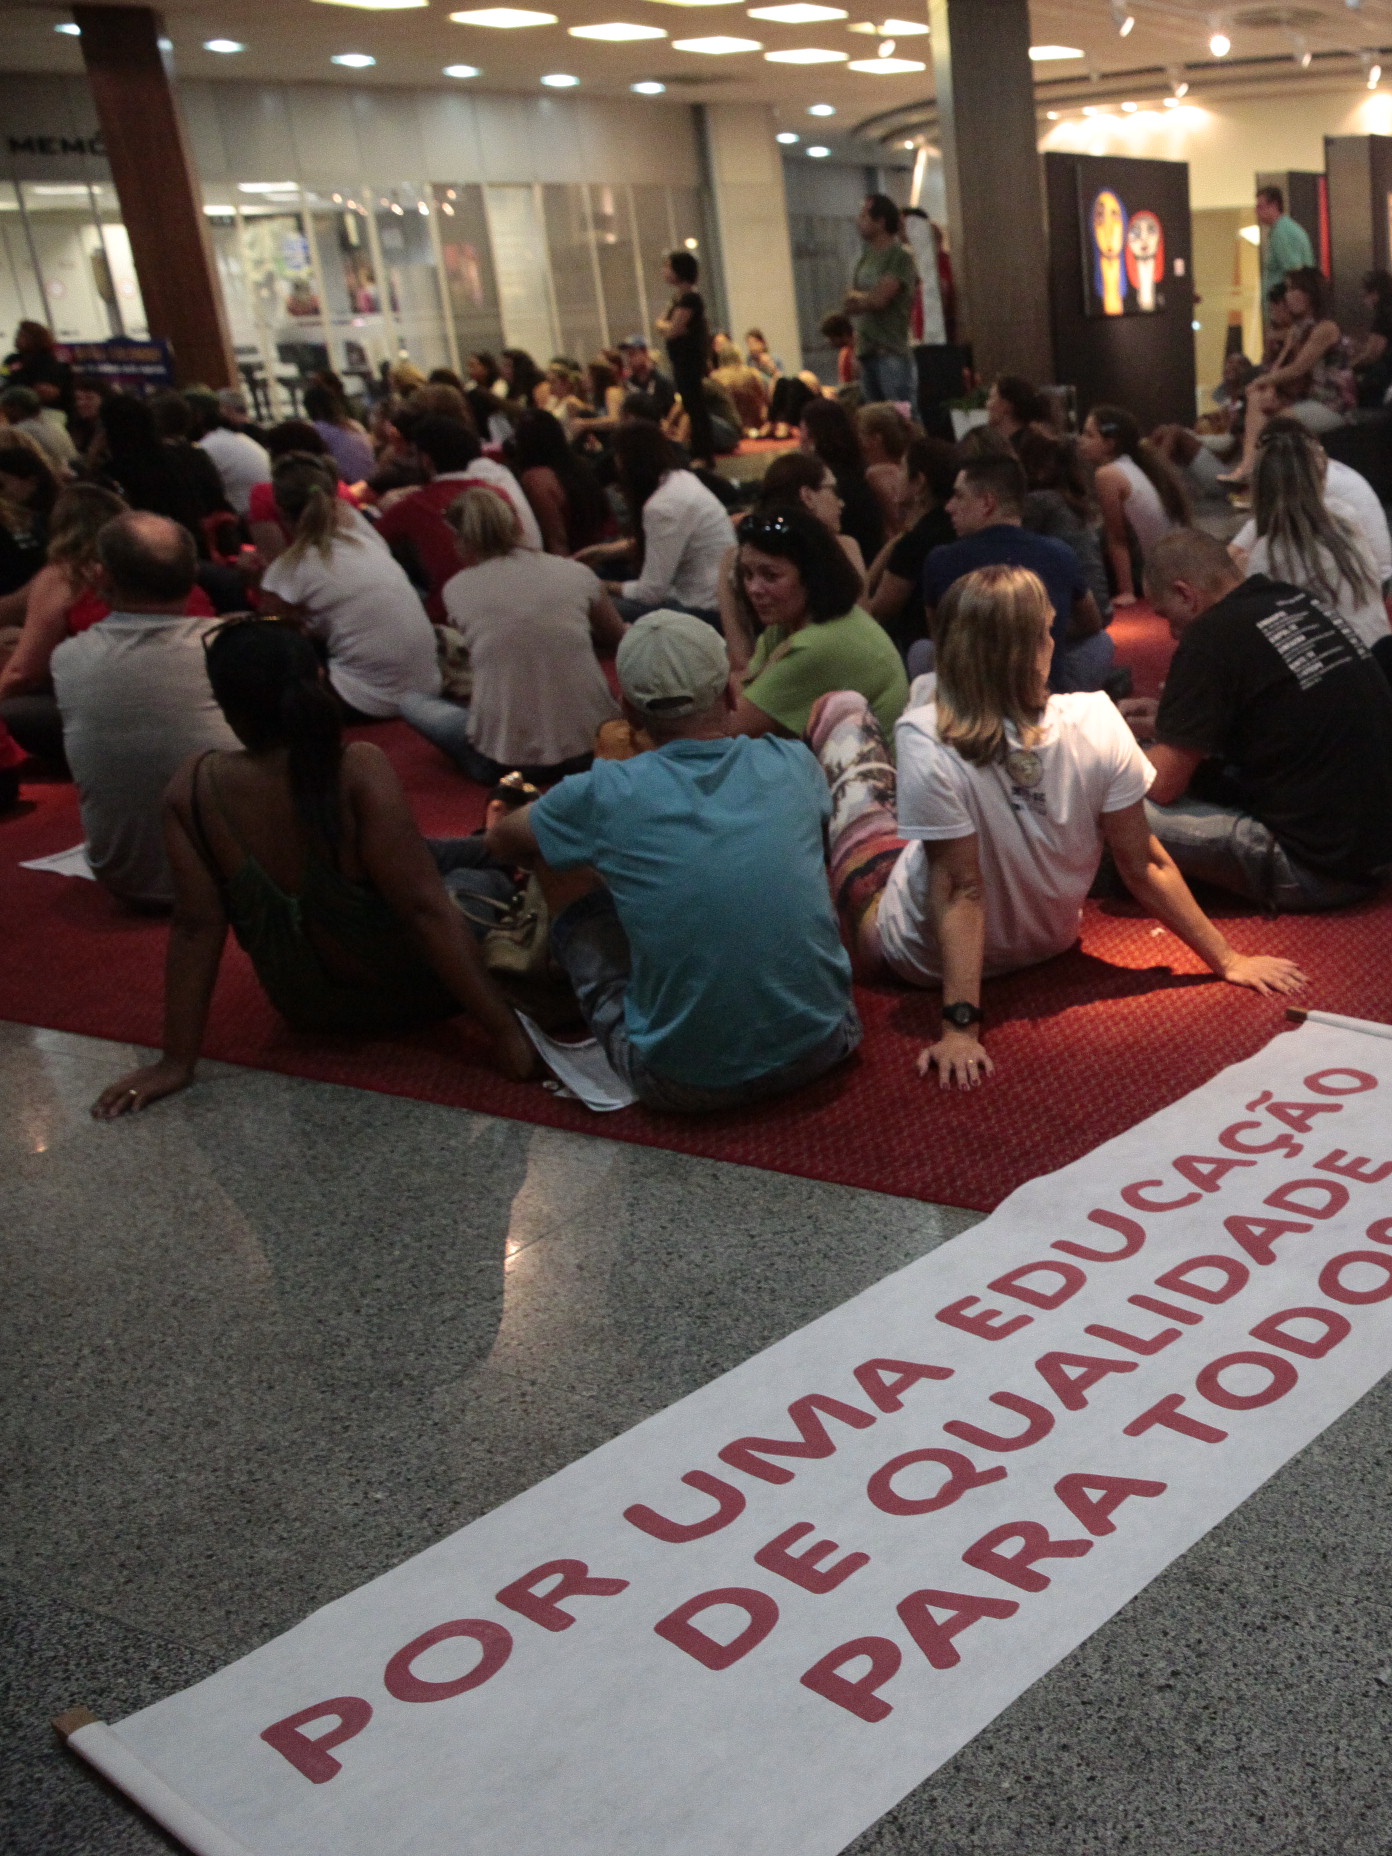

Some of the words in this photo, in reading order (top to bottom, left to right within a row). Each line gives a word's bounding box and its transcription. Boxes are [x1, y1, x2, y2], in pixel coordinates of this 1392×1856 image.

[261, 1559, 628, 1783] POR
[625, 1358, 954, 1543] UMA
[936, 1068, 1378, 1340] EDUCAÇÃO
[655, 1522, 870, 1670] DE
[801, 1473, 1166, 1722] PARA
